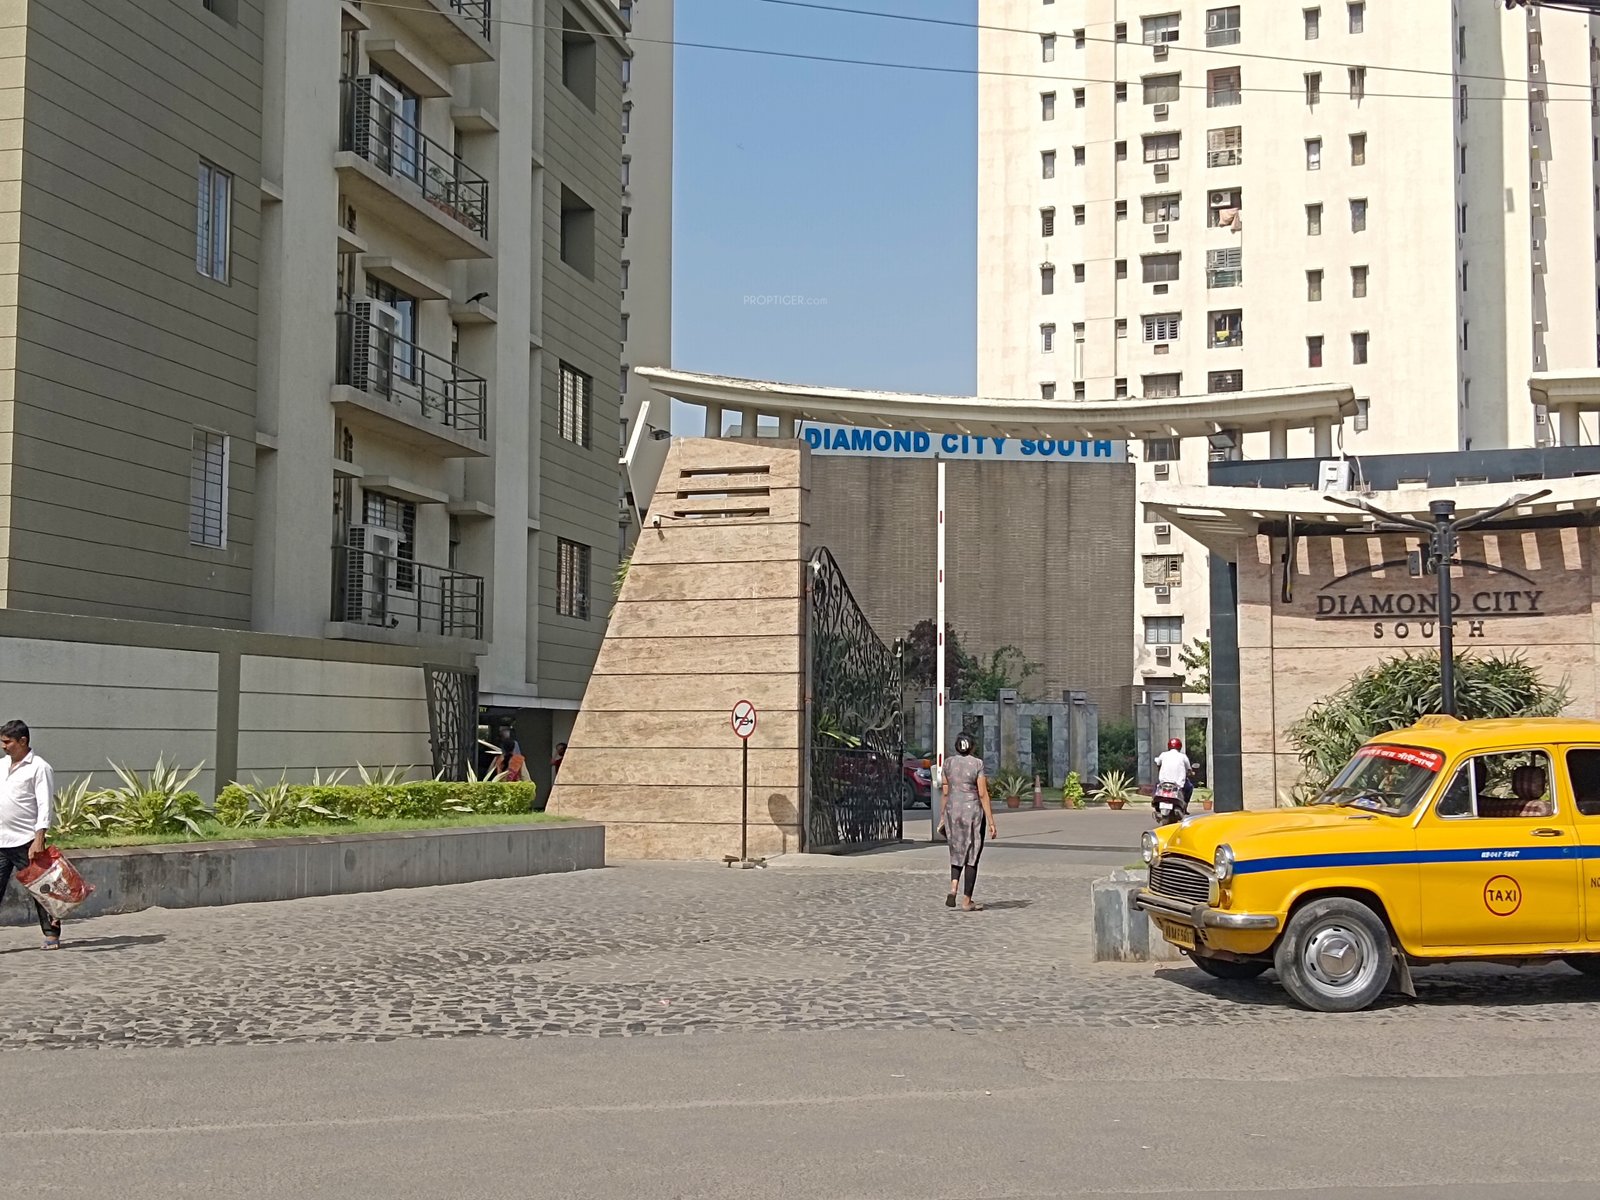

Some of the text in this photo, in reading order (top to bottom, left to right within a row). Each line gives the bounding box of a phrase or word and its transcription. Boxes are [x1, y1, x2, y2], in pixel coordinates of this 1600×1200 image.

[805, 427, 1112, 458] DIAMOND CITY SOUTH
[1472, 590, 1544, 612] CITY
[1487, 889, 1517, 902] TAXI
